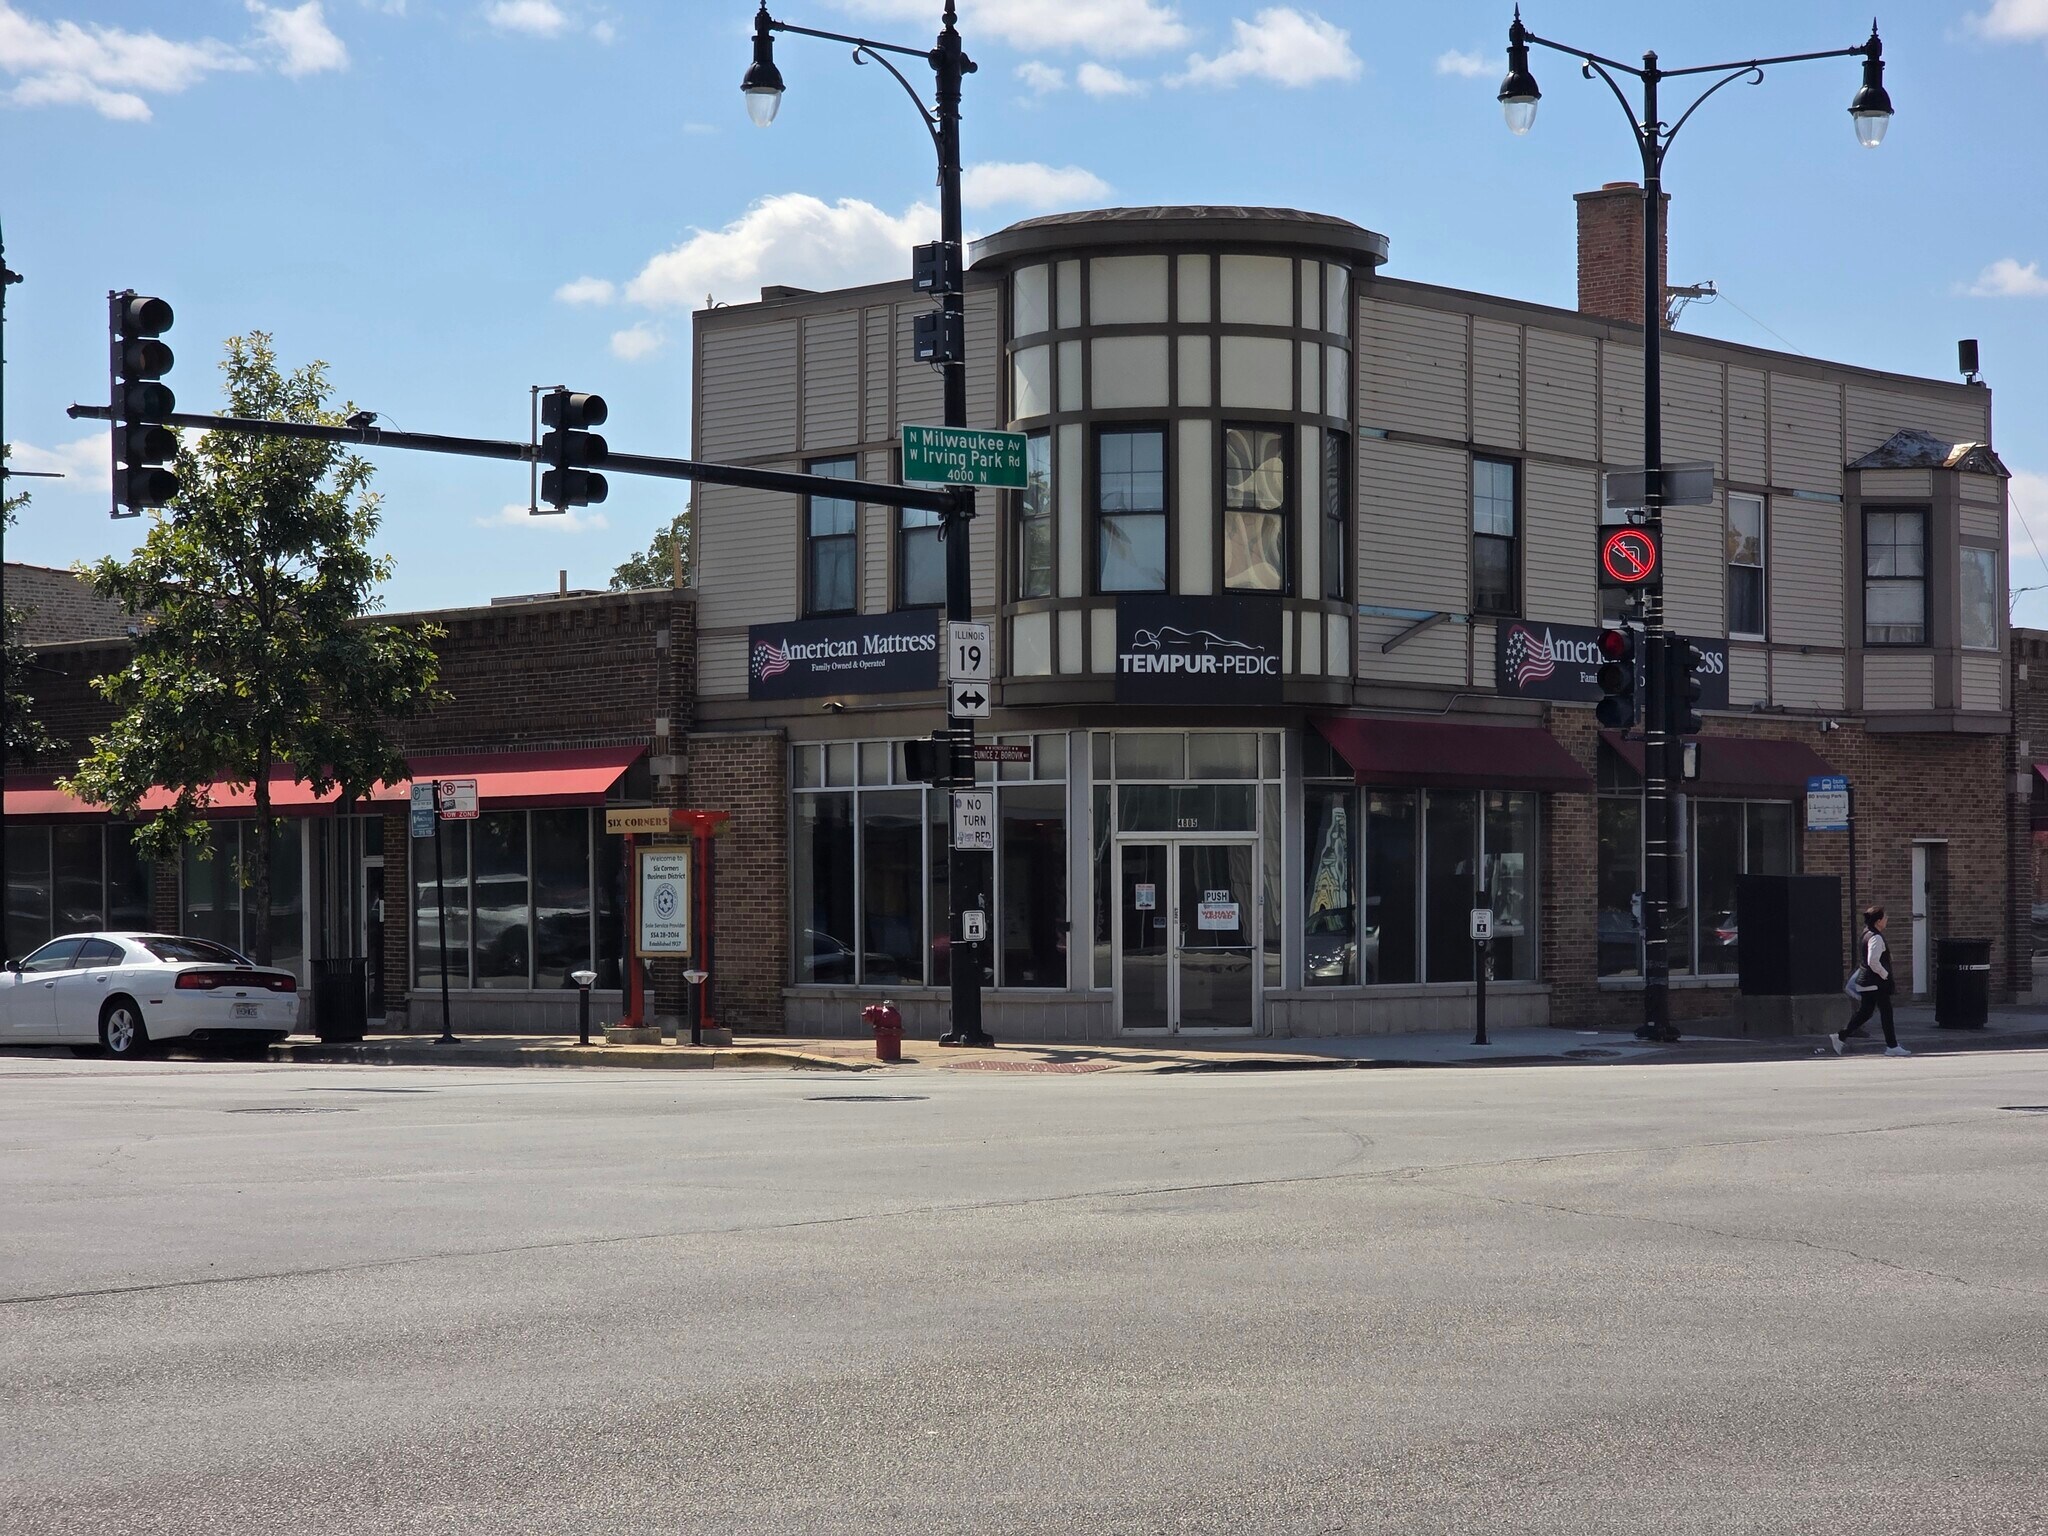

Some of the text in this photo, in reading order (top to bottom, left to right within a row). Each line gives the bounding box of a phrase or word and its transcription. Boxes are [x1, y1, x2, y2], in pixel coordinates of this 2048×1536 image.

[910, 430, 1020, 451] N Milwaukee Av
[910, 448, 1020, 470] W Irving Park Rd
[947, 470, 987, 482] 4000 N
[955, 630, 984, 640] ILLINOIS
[779, 634, 936, 660] American Mattress
[960, 646, 981, 672] 19
[1120, 654, 1277, 674] TEMPUR-PEDIC
[812, 659, 886, 672] Family Owned & Operated
[974, 750, 993, 759] EUNICE
[1000, 751, 1023, 760] BOROVIK
[967, 800, 982, 810] NO
[608, 817, 668, 827] SIX CORNERS
[963, 815, 986, 826] TURN
[1206, 892, 1227, 900] PUSH
